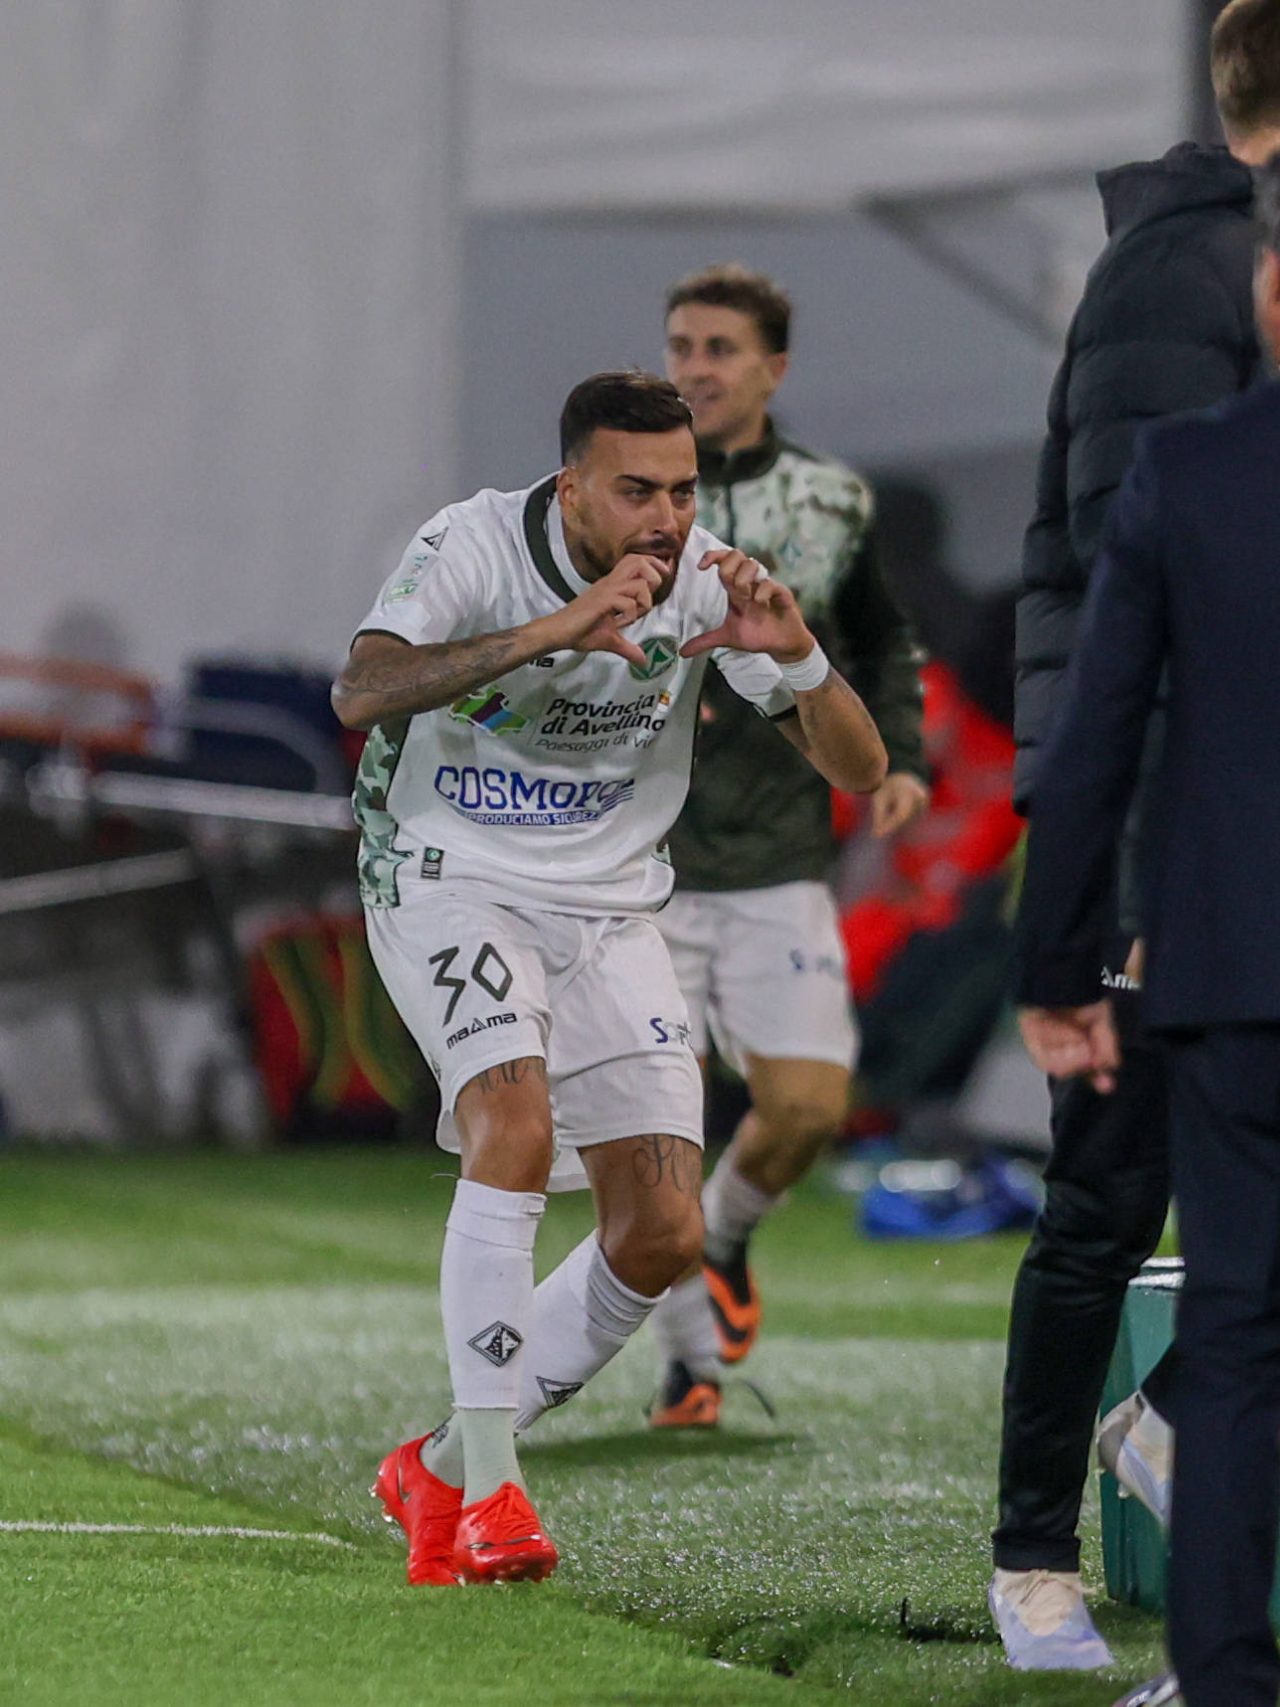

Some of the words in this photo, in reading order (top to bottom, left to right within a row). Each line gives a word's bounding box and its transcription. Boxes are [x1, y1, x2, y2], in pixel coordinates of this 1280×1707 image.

[546, 694, 655, 718] Provincia
[541, 716, 565, 735] di
[569, 711, 666, 736] Avellino
[428, 942, 514, 1029] 30
